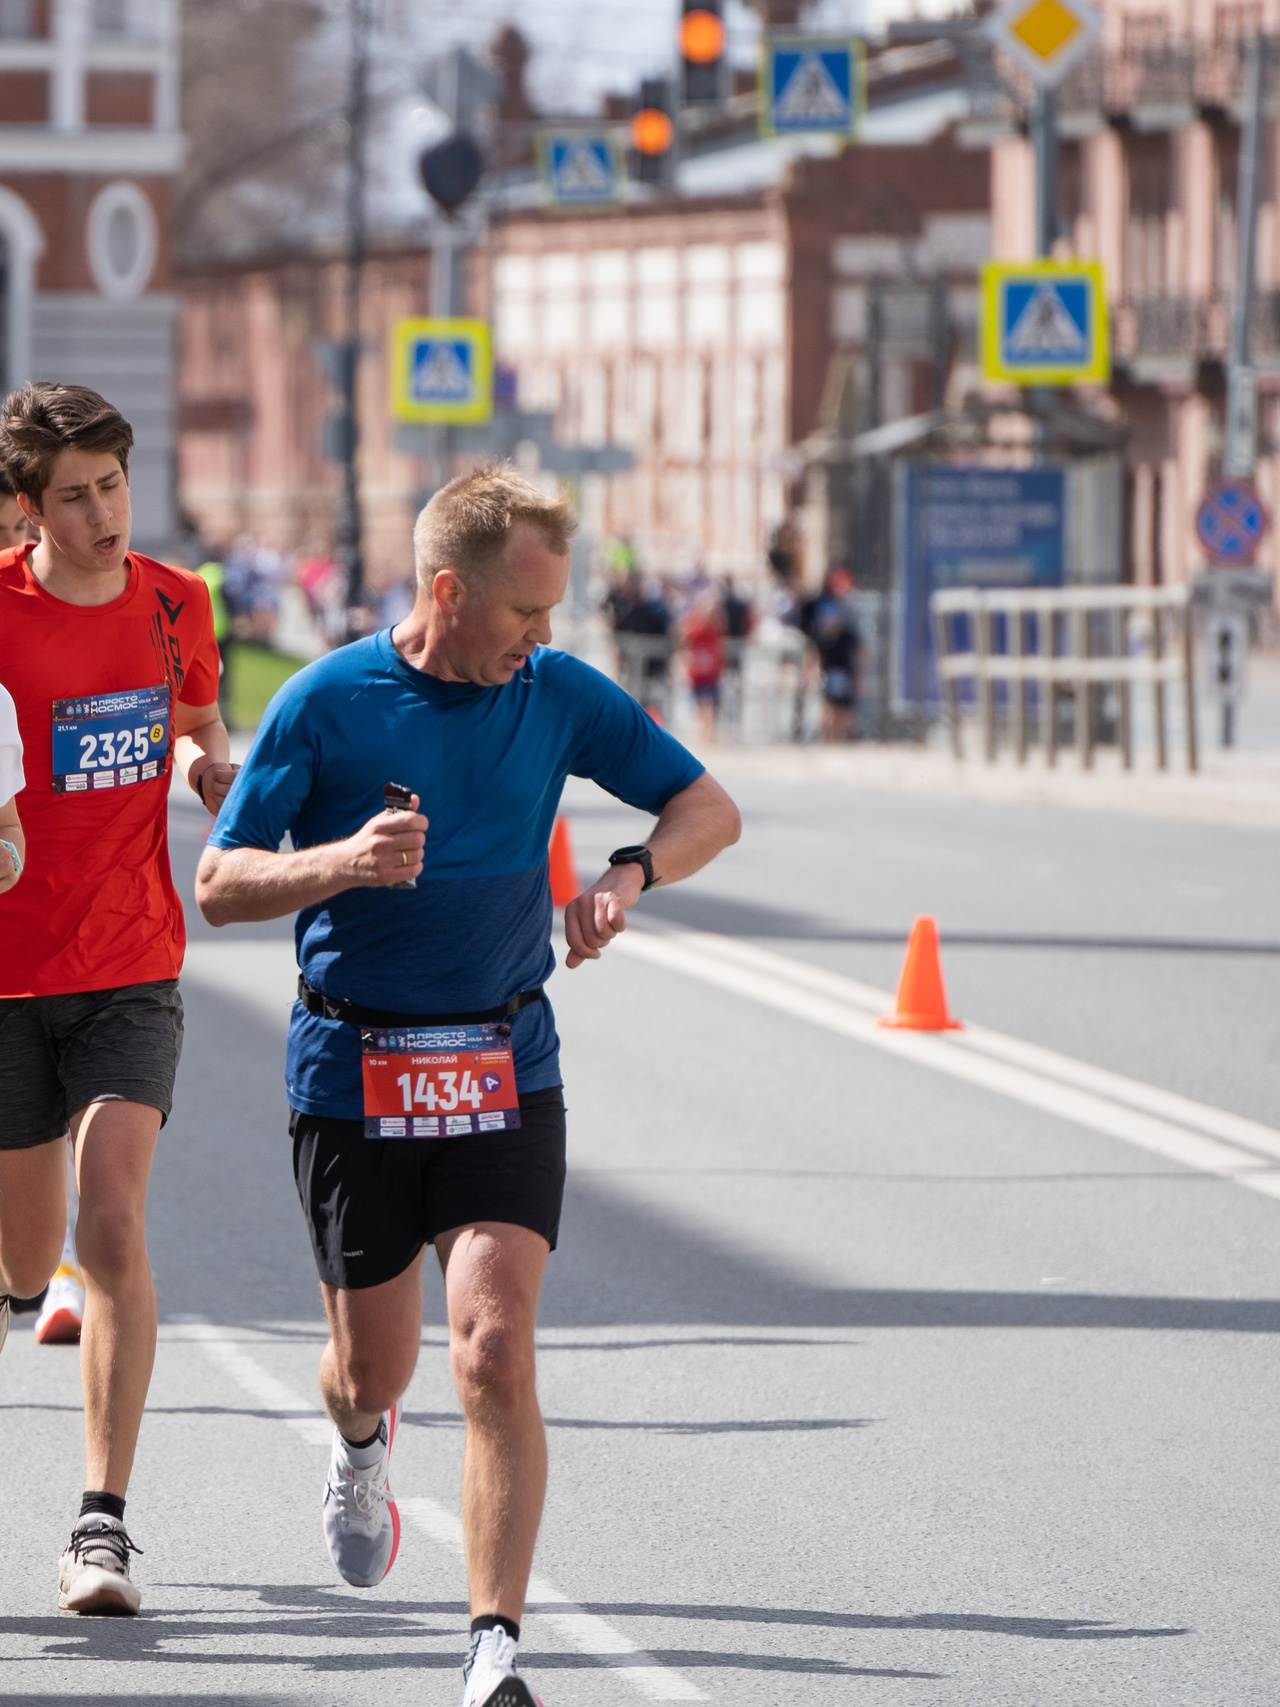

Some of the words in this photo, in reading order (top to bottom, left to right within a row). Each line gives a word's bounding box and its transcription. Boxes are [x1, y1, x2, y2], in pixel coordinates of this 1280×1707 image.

[98, 695, 138, 706] ПРОСТО
[90, 701, 138, 714] КОСМОС
[153, 728, 161, 739] B
[79, 726, 149, 769] 2325
[417, 1031, 466, 1039] ПРОСТО
[407, 1039, 466, 1048] КОСМОС
[411, 1055, 458, 1065] НИКОЛАЙ
[397, 1070, 483, 1112] 1434
